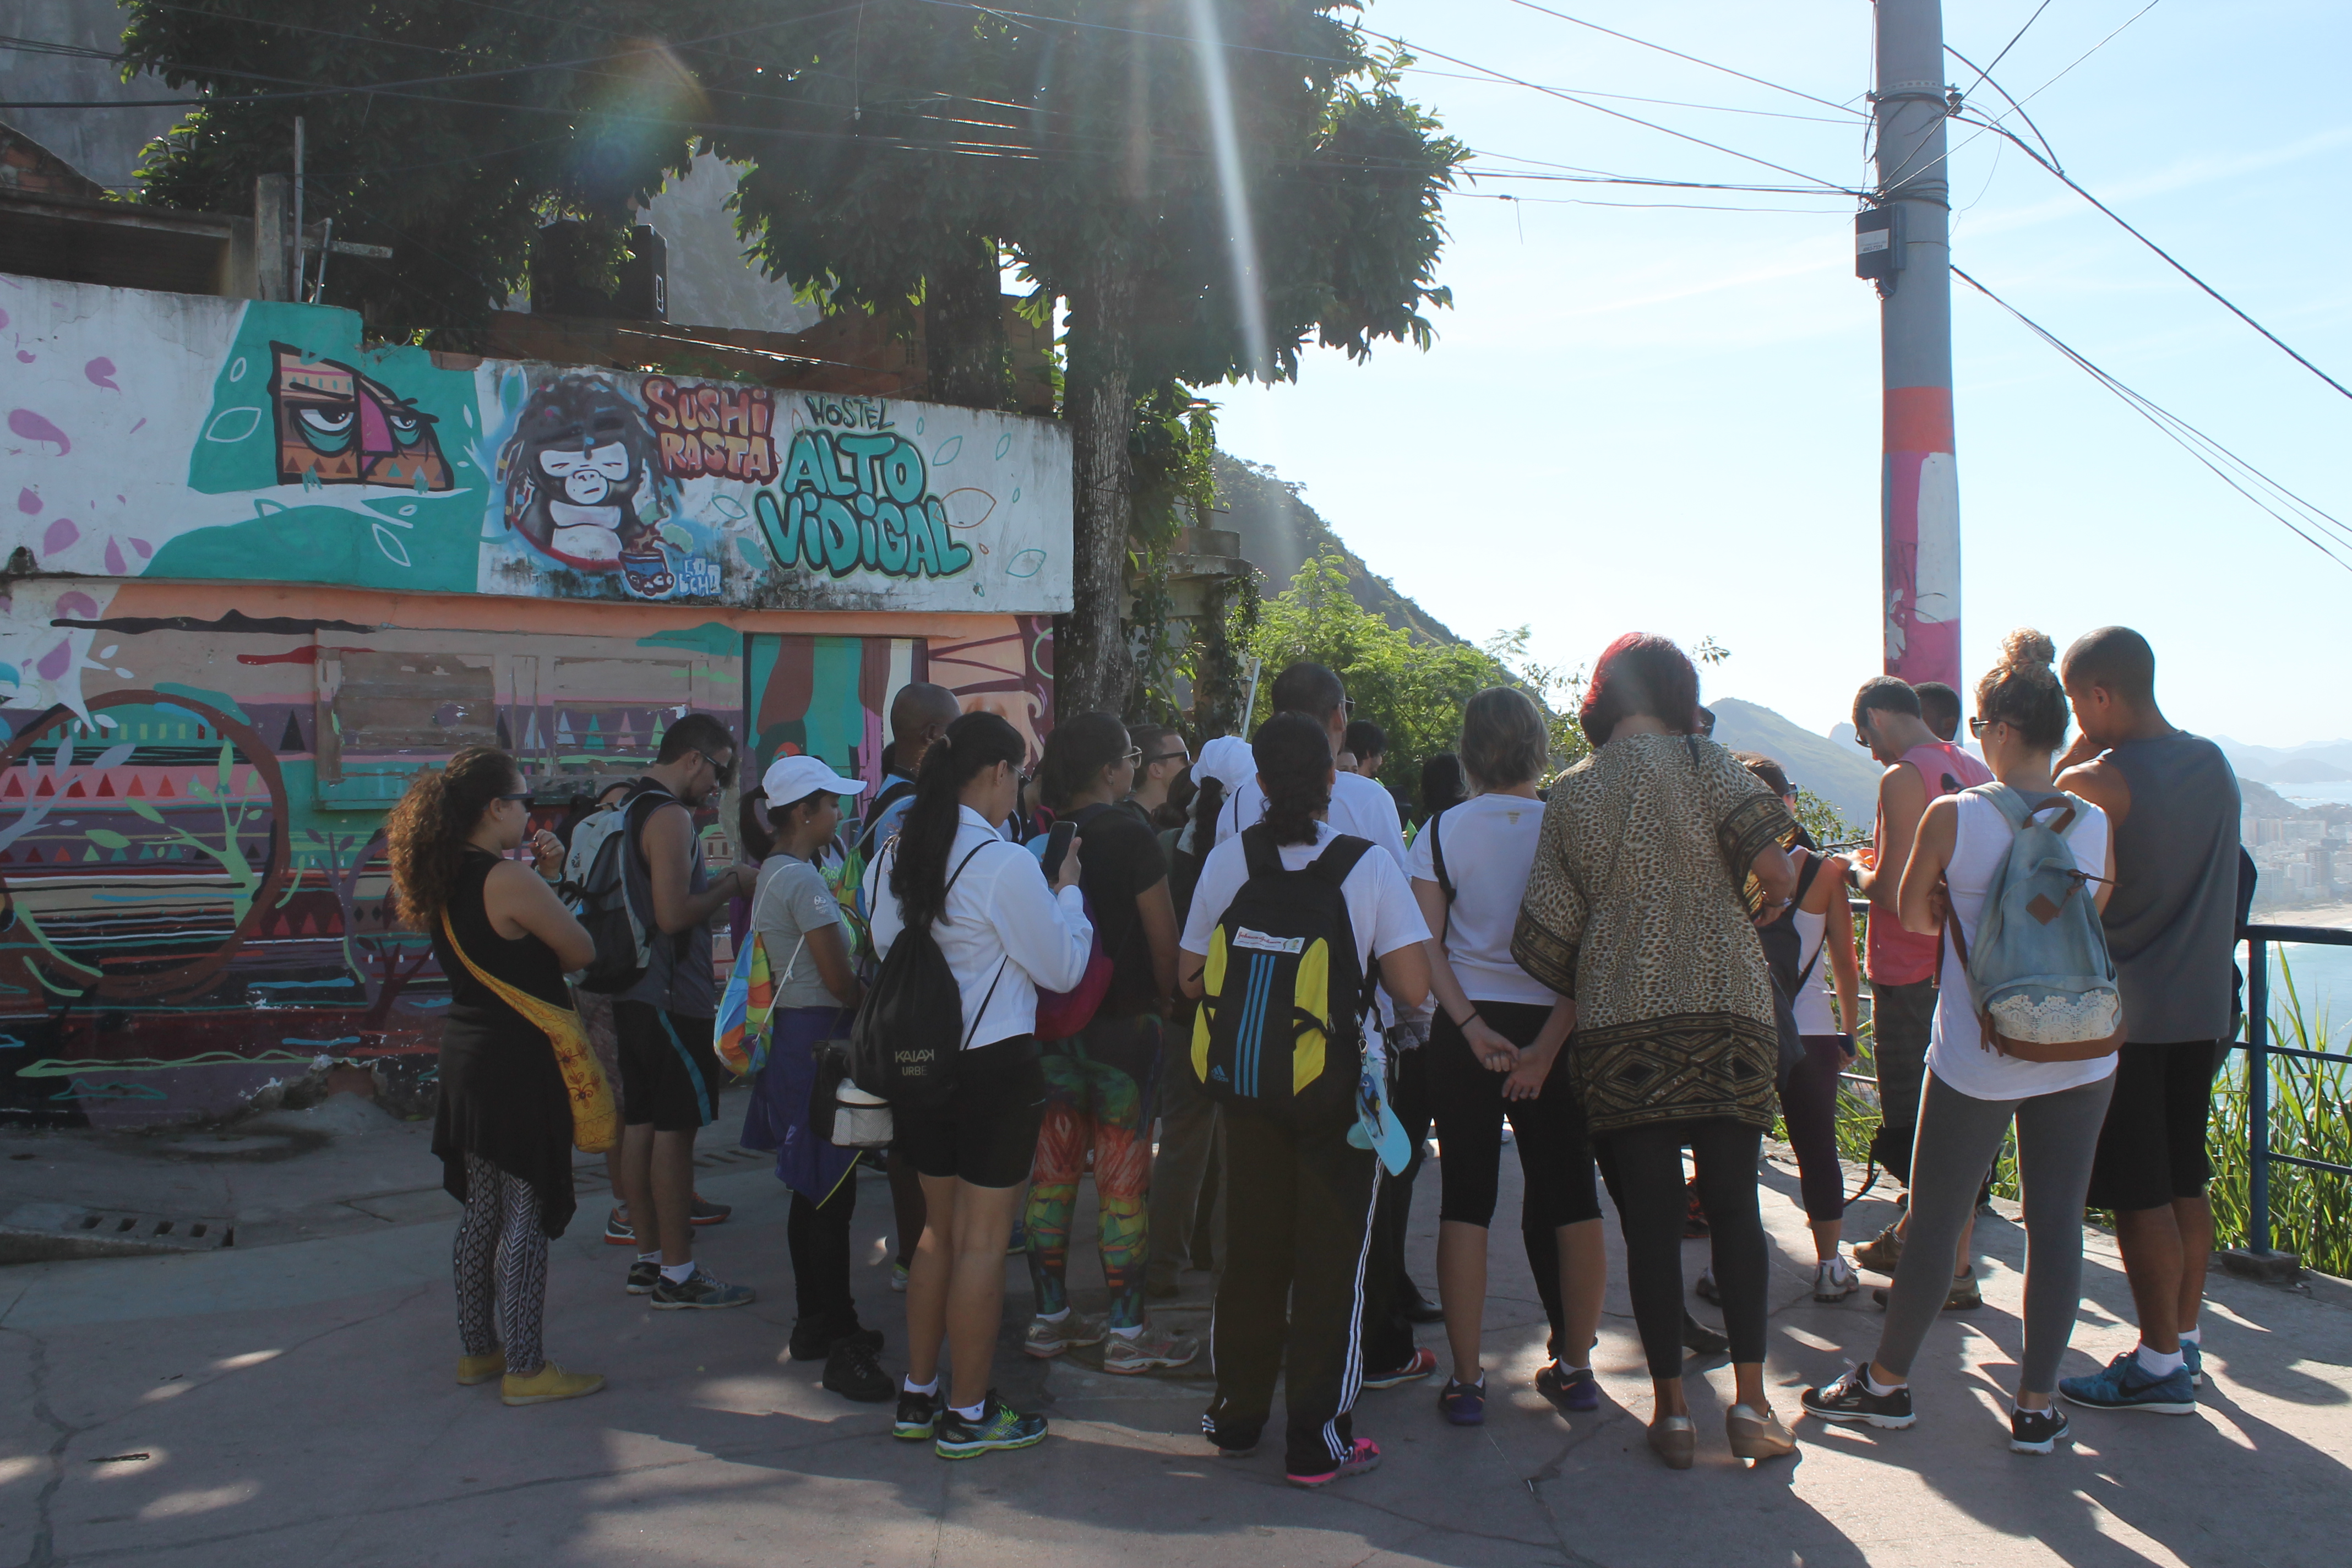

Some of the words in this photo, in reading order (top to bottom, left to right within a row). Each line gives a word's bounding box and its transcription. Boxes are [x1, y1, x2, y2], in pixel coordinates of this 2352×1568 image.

[804, 395, 895, 431] HOSTEL
[659, 430, 776, 483] RASTA
[781, 428, 927, 506] ALTO
[902, 1065, 928, 1076] URBE
